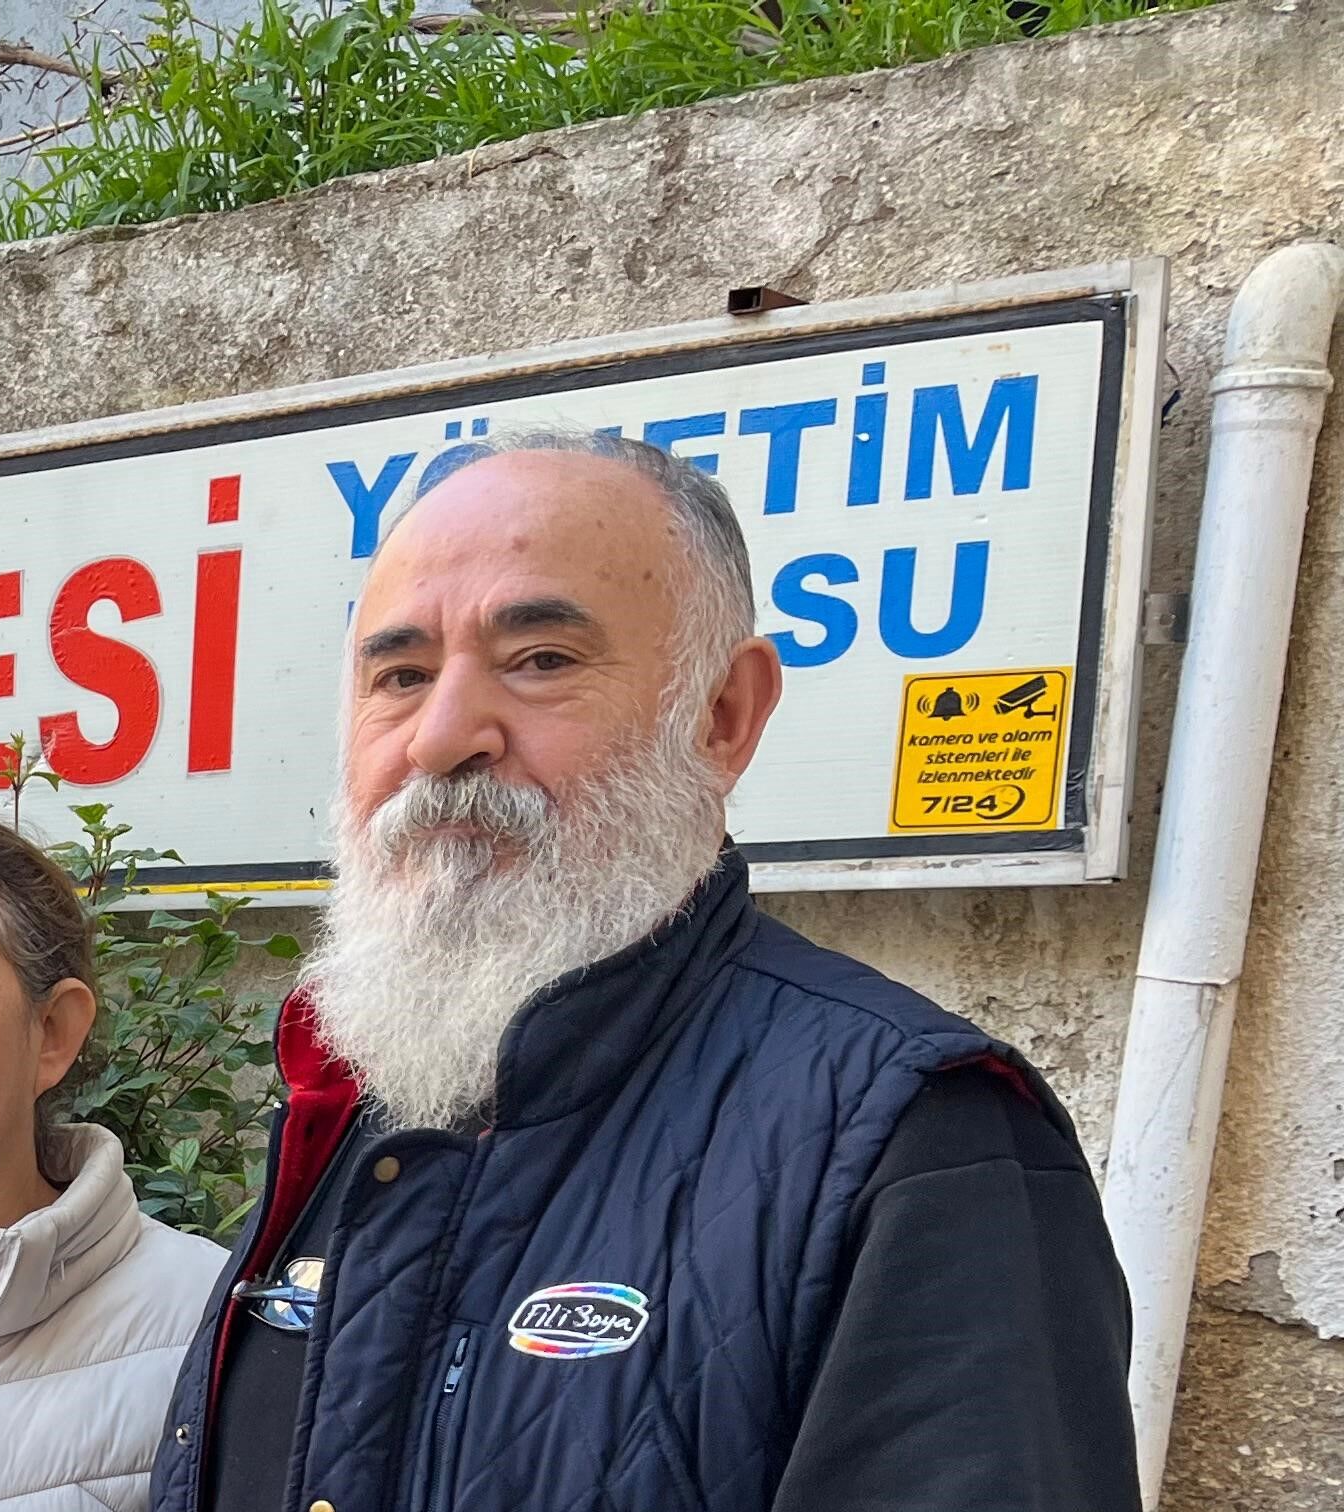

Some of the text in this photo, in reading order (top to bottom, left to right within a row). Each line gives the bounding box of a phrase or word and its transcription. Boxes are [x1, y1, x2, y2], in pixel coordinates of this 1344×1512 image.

[326, 361, 1039, 560] YTİM
[908, 729, 1052, 747] kamera ve alarm
[925, 747, 1032, 765] sistemleri ile
[573, 1304, 634, 1337] Boya
